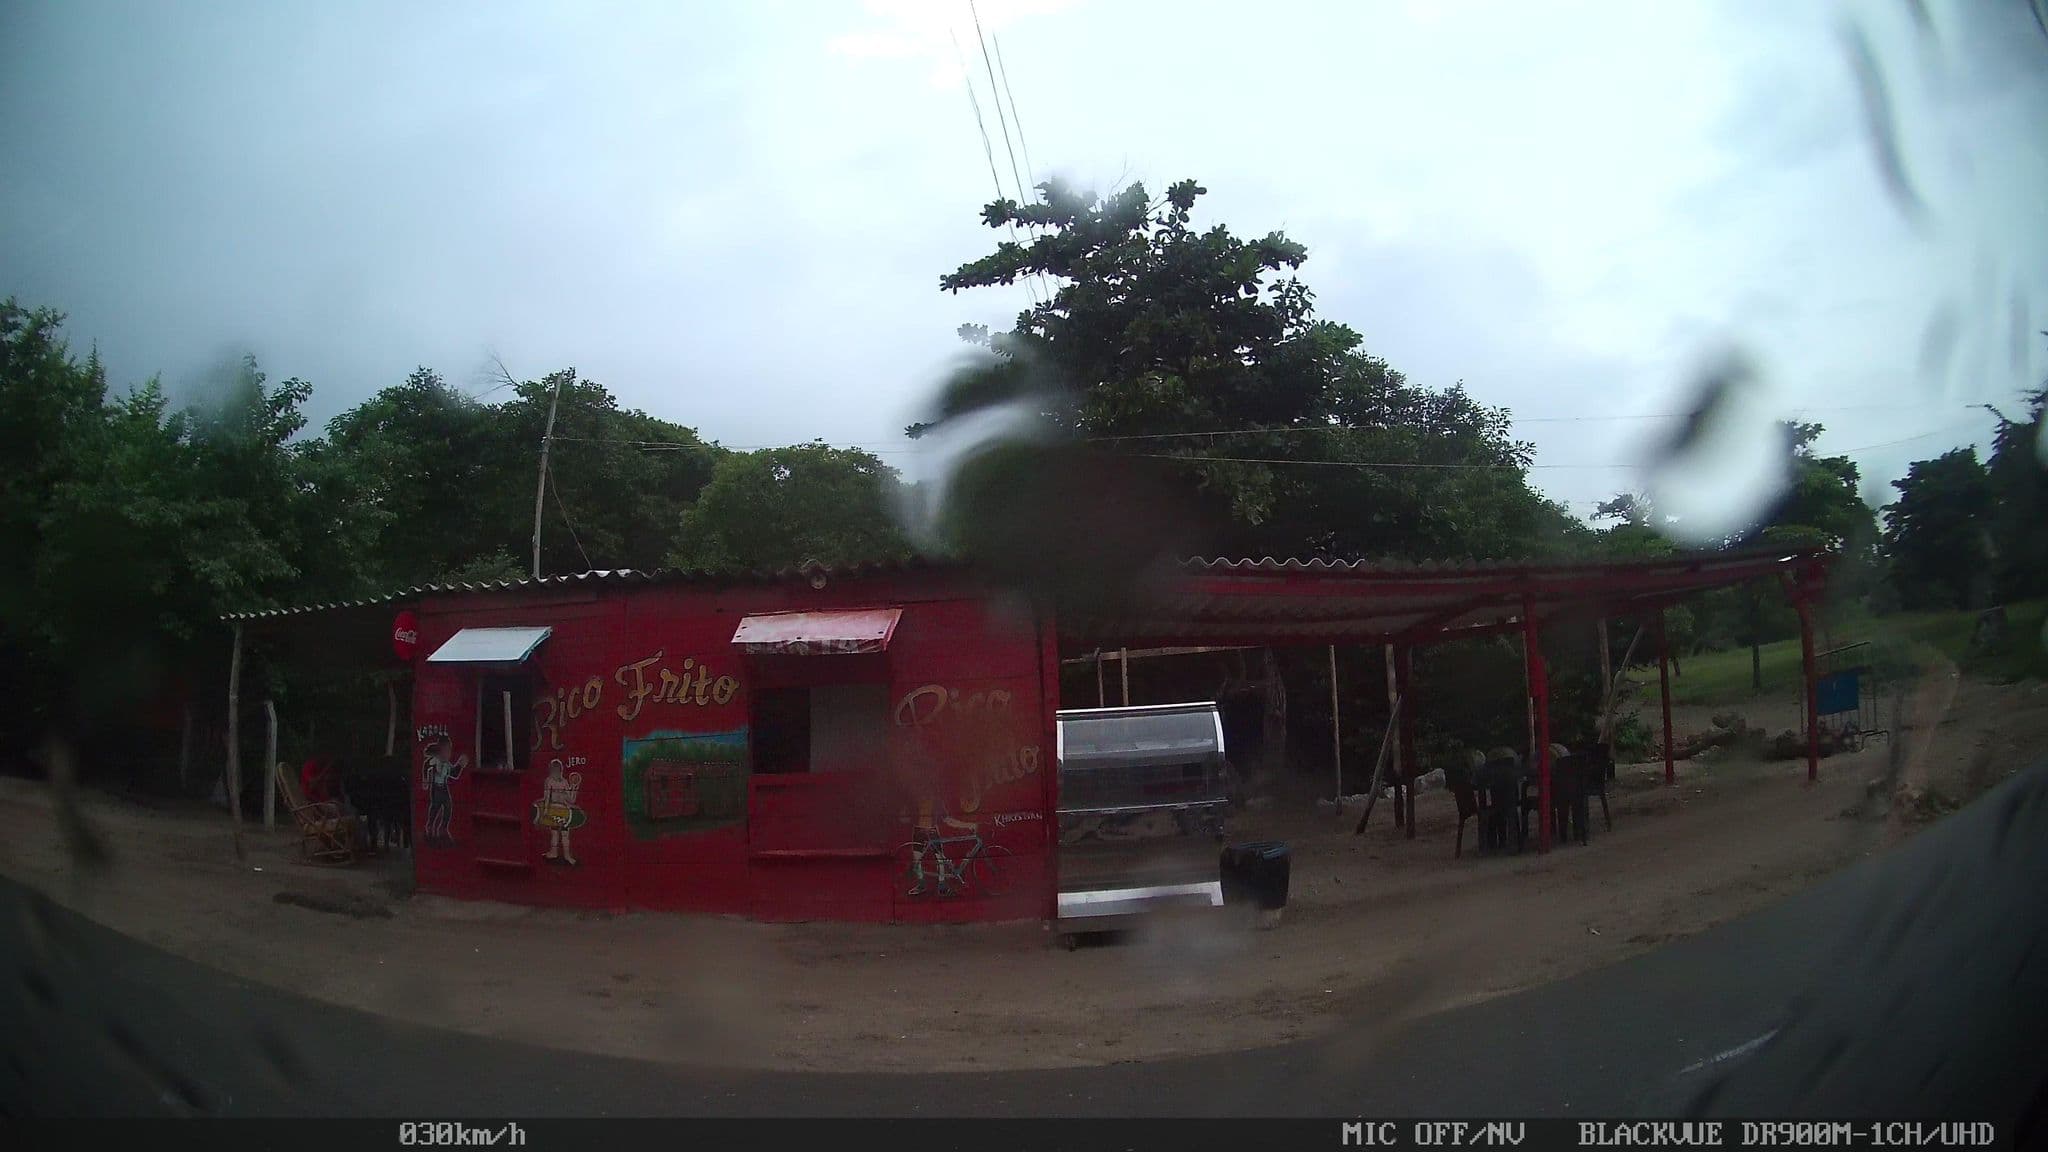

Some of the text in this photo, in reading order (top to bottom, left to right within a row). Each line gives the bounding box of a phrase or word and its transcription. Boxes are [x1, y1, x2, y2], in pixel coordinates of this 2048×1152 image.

[531, 651, 741, 751] Rico Frito
[565, 756, 587, 769] JERO
